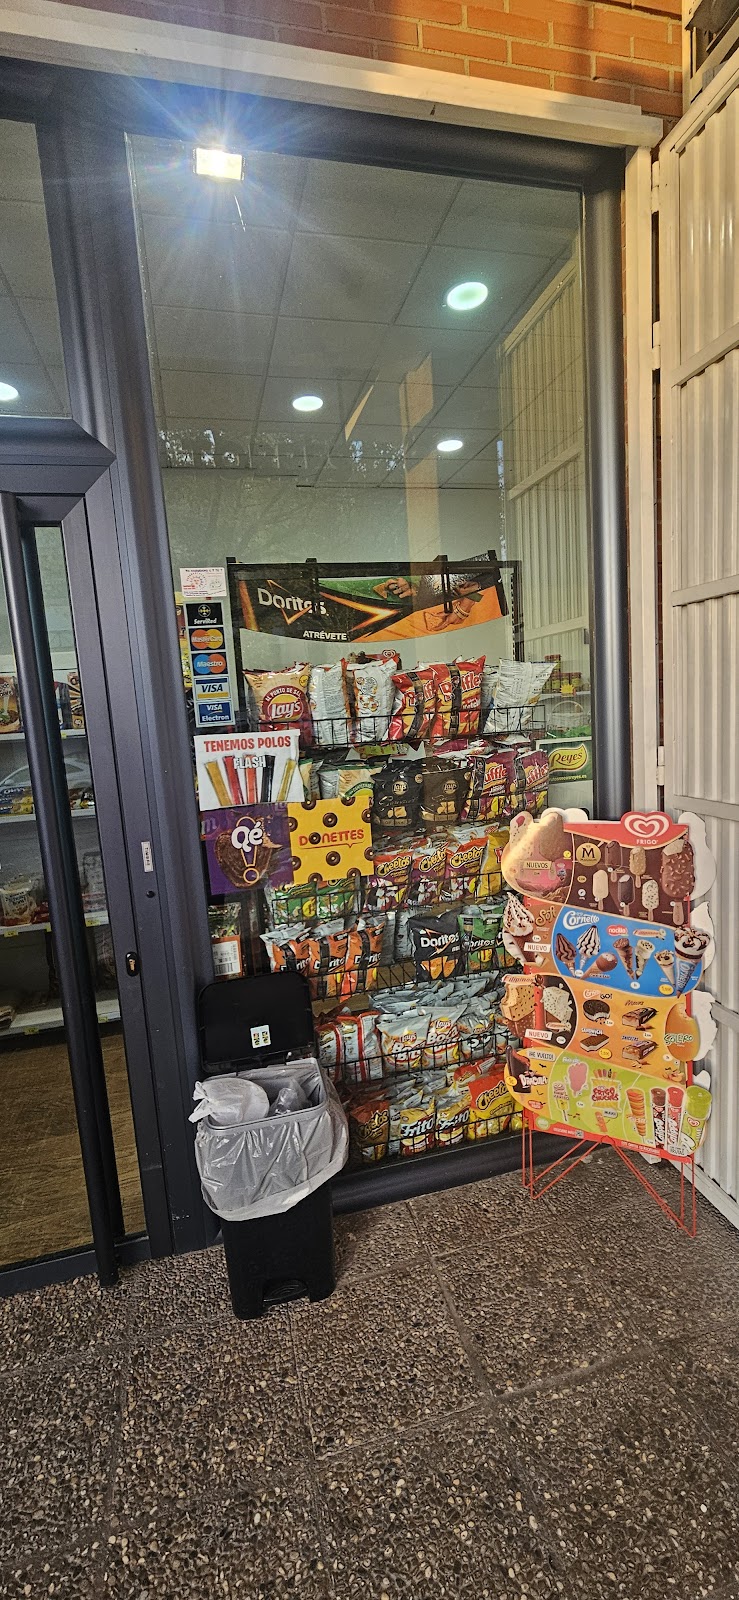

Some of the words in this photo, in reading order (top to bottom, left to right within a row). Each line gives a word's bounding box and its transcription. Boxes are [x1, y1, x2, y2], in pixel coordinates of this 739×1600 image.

[193, 617, 217, 625] ServiRed
[191, 635, 222, 643] MasterCard
[303, 629, 348, 641] ATRÉVETE
[197, 660, 223, 668] Maestro
[201, 683, 223, 693] VISA
[206, 703, 223, 711] VISA
[271, 701, 301, 719] Lay's
[201, 714, 230, 722] Electron
[203, 738, 255, 753] TENEMOS
[257, 736, 292, 749] POLOS
[233, 755, 267, 770] FLASH
[553, 750, 583, 766] Reyes
[231, 821, 264, 852] Qé
[298, 829, 364, 847] DONETTES
[419, 848, 447, 872] Cheeto
[582, 847, 595, 859] M
[375, 855, 411, 877] Cheetos
[562, 910, 600, 930] Cornetto
[607, 926, 627, 934] nocilla
[420, 932, 460, 948] Doritos
[528, 1031, 549, 1039] NUEVO
[663, 1033, 694, 1045] SOLERO
[476, 1082, 509, 1110] Cheeto
[400, 1117, 434, 1137] Frito
[439, 1109, 470, 1130] Frito
